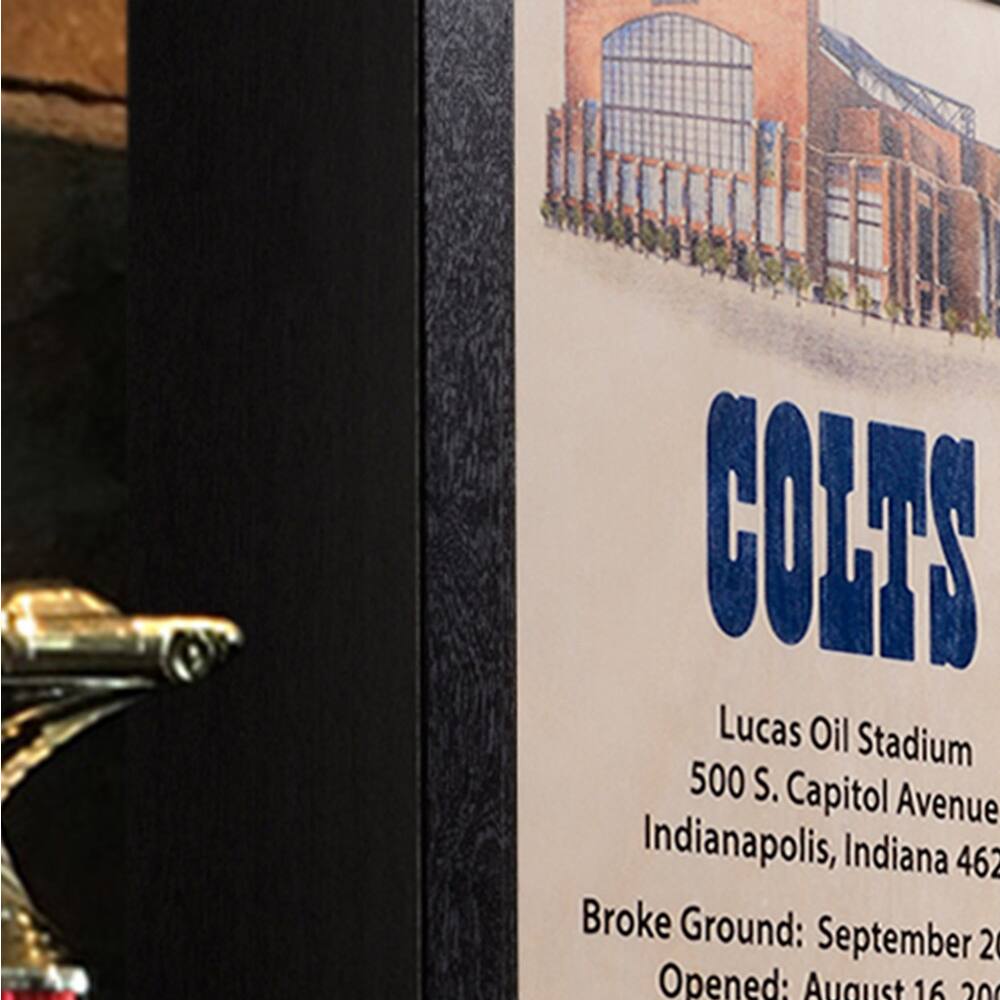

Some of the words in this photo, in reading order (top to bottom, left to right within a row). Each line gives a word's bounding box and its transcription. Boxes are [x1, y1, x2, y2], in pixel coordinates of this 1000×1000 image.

[706, 391, 978, 670] COLTS
[719, 704, 803, 749] Lucas
[809, 714, 849, 752] Oil
[857, 721, 973, 767] Stadium
[690, 760, 745, 799] 500
[754, 766, 778, 803] S.
[786, 770, 888, 817] Capitol
[896, 781, 999, 825] Avenue
[645, 813, 836, 870] Indianapolis,
[845, 832, 949, 875] Indiana
[583, 898, 672, 940] Broke
[680, 904, 802, 948] Ground:
[818, 915, 972, 961] September
